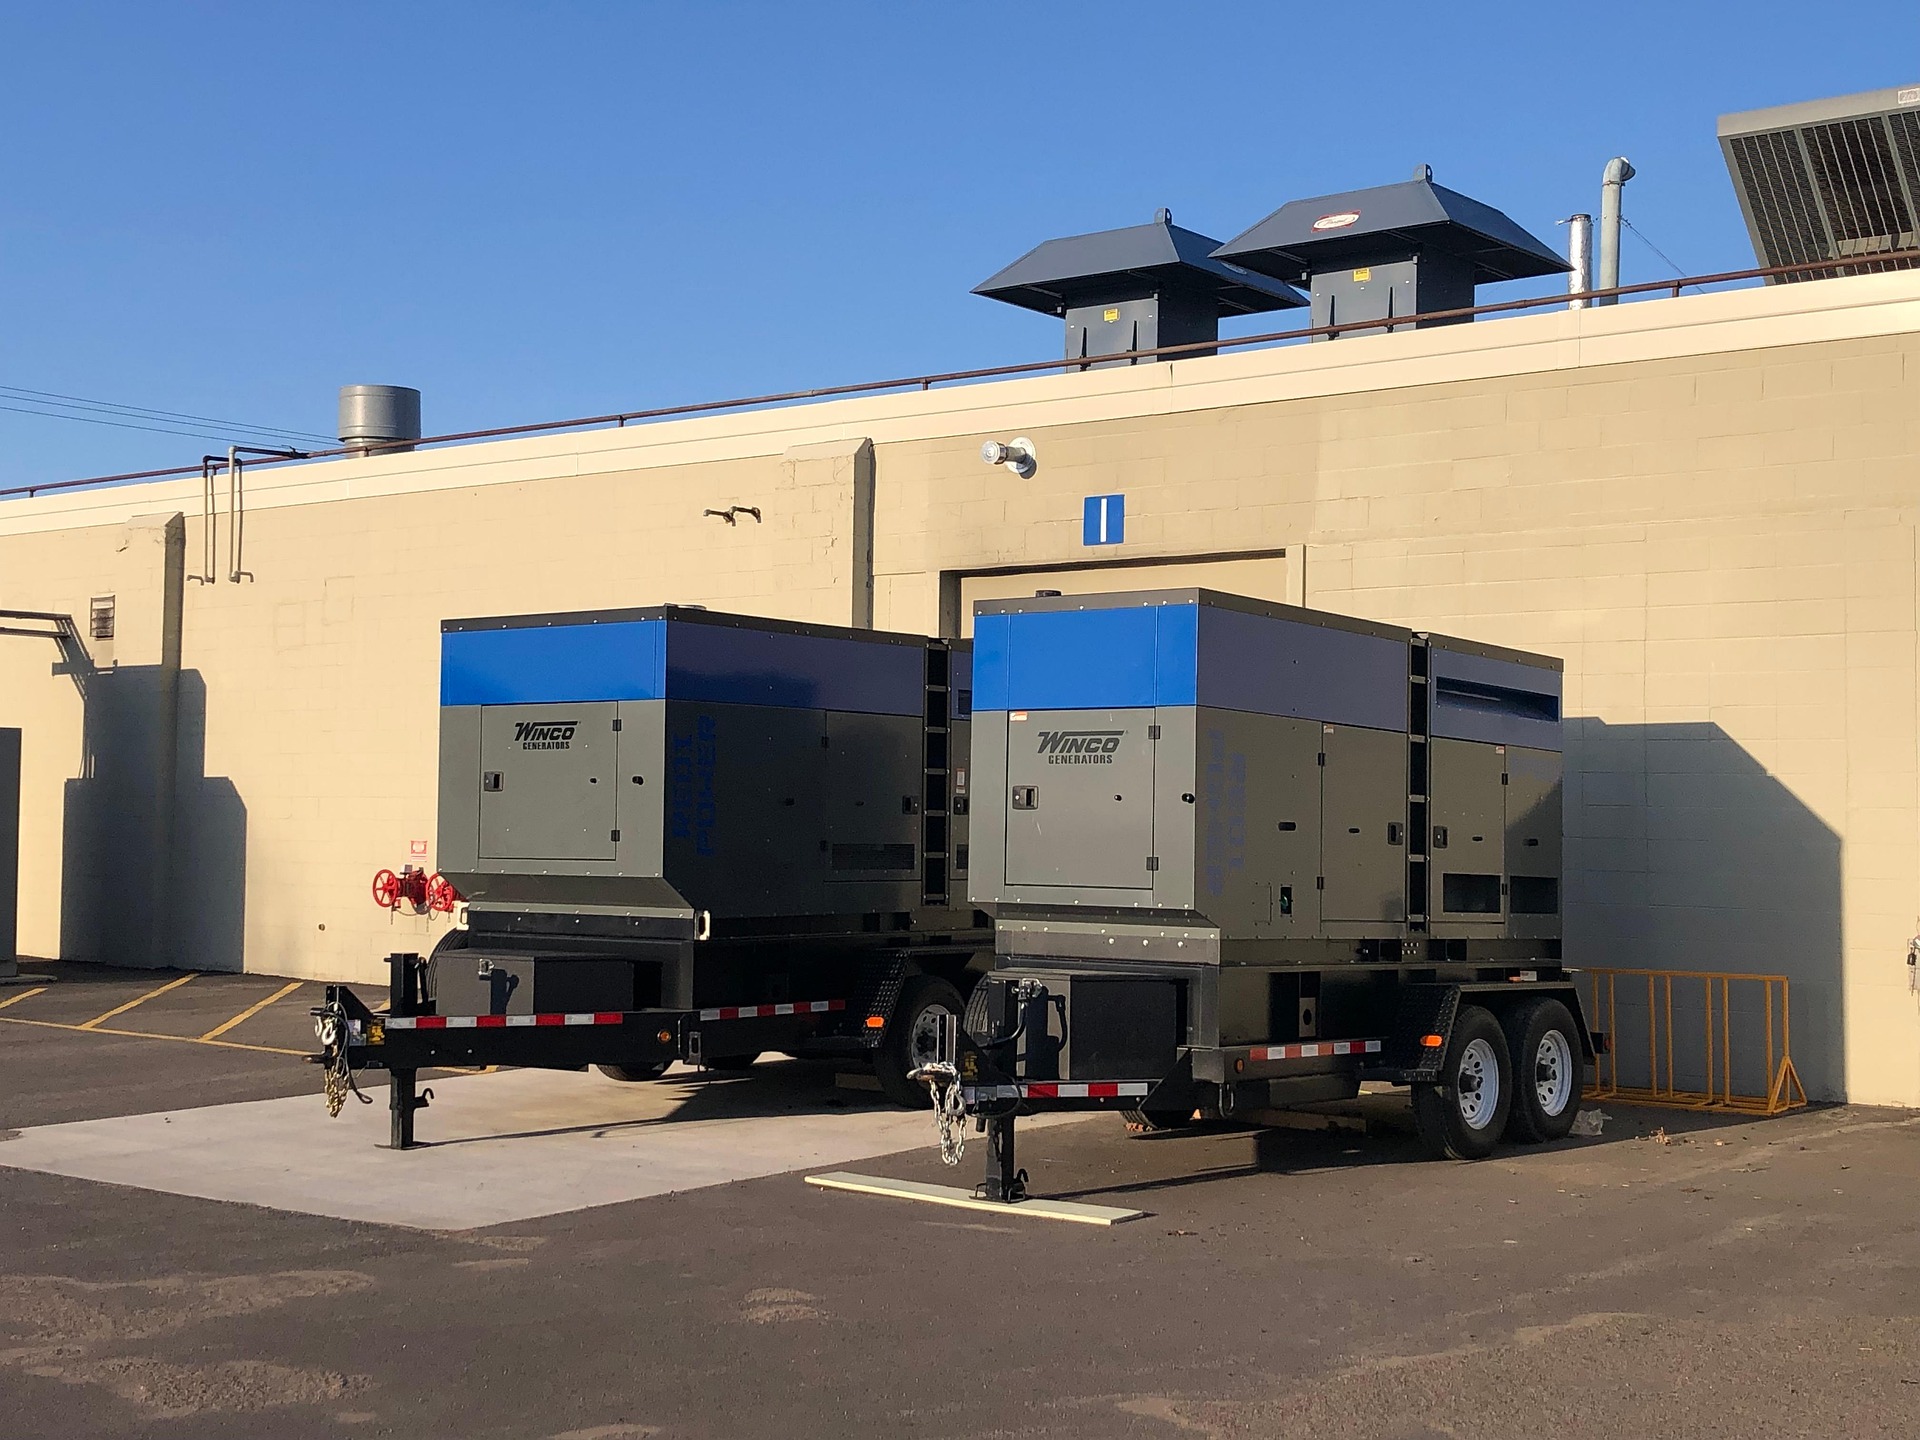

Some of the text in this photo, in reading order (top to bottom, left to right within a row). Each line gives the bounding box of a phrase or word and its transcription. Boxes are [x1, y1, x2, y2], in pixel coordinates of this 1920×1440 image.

[514, 720, 579, 741] WINCO
[522, 741, 571, 750] GENERATORS
[1037, 730, 1125, 754] WINCO
[1048, 754, 1114, 765] GENERATORS
